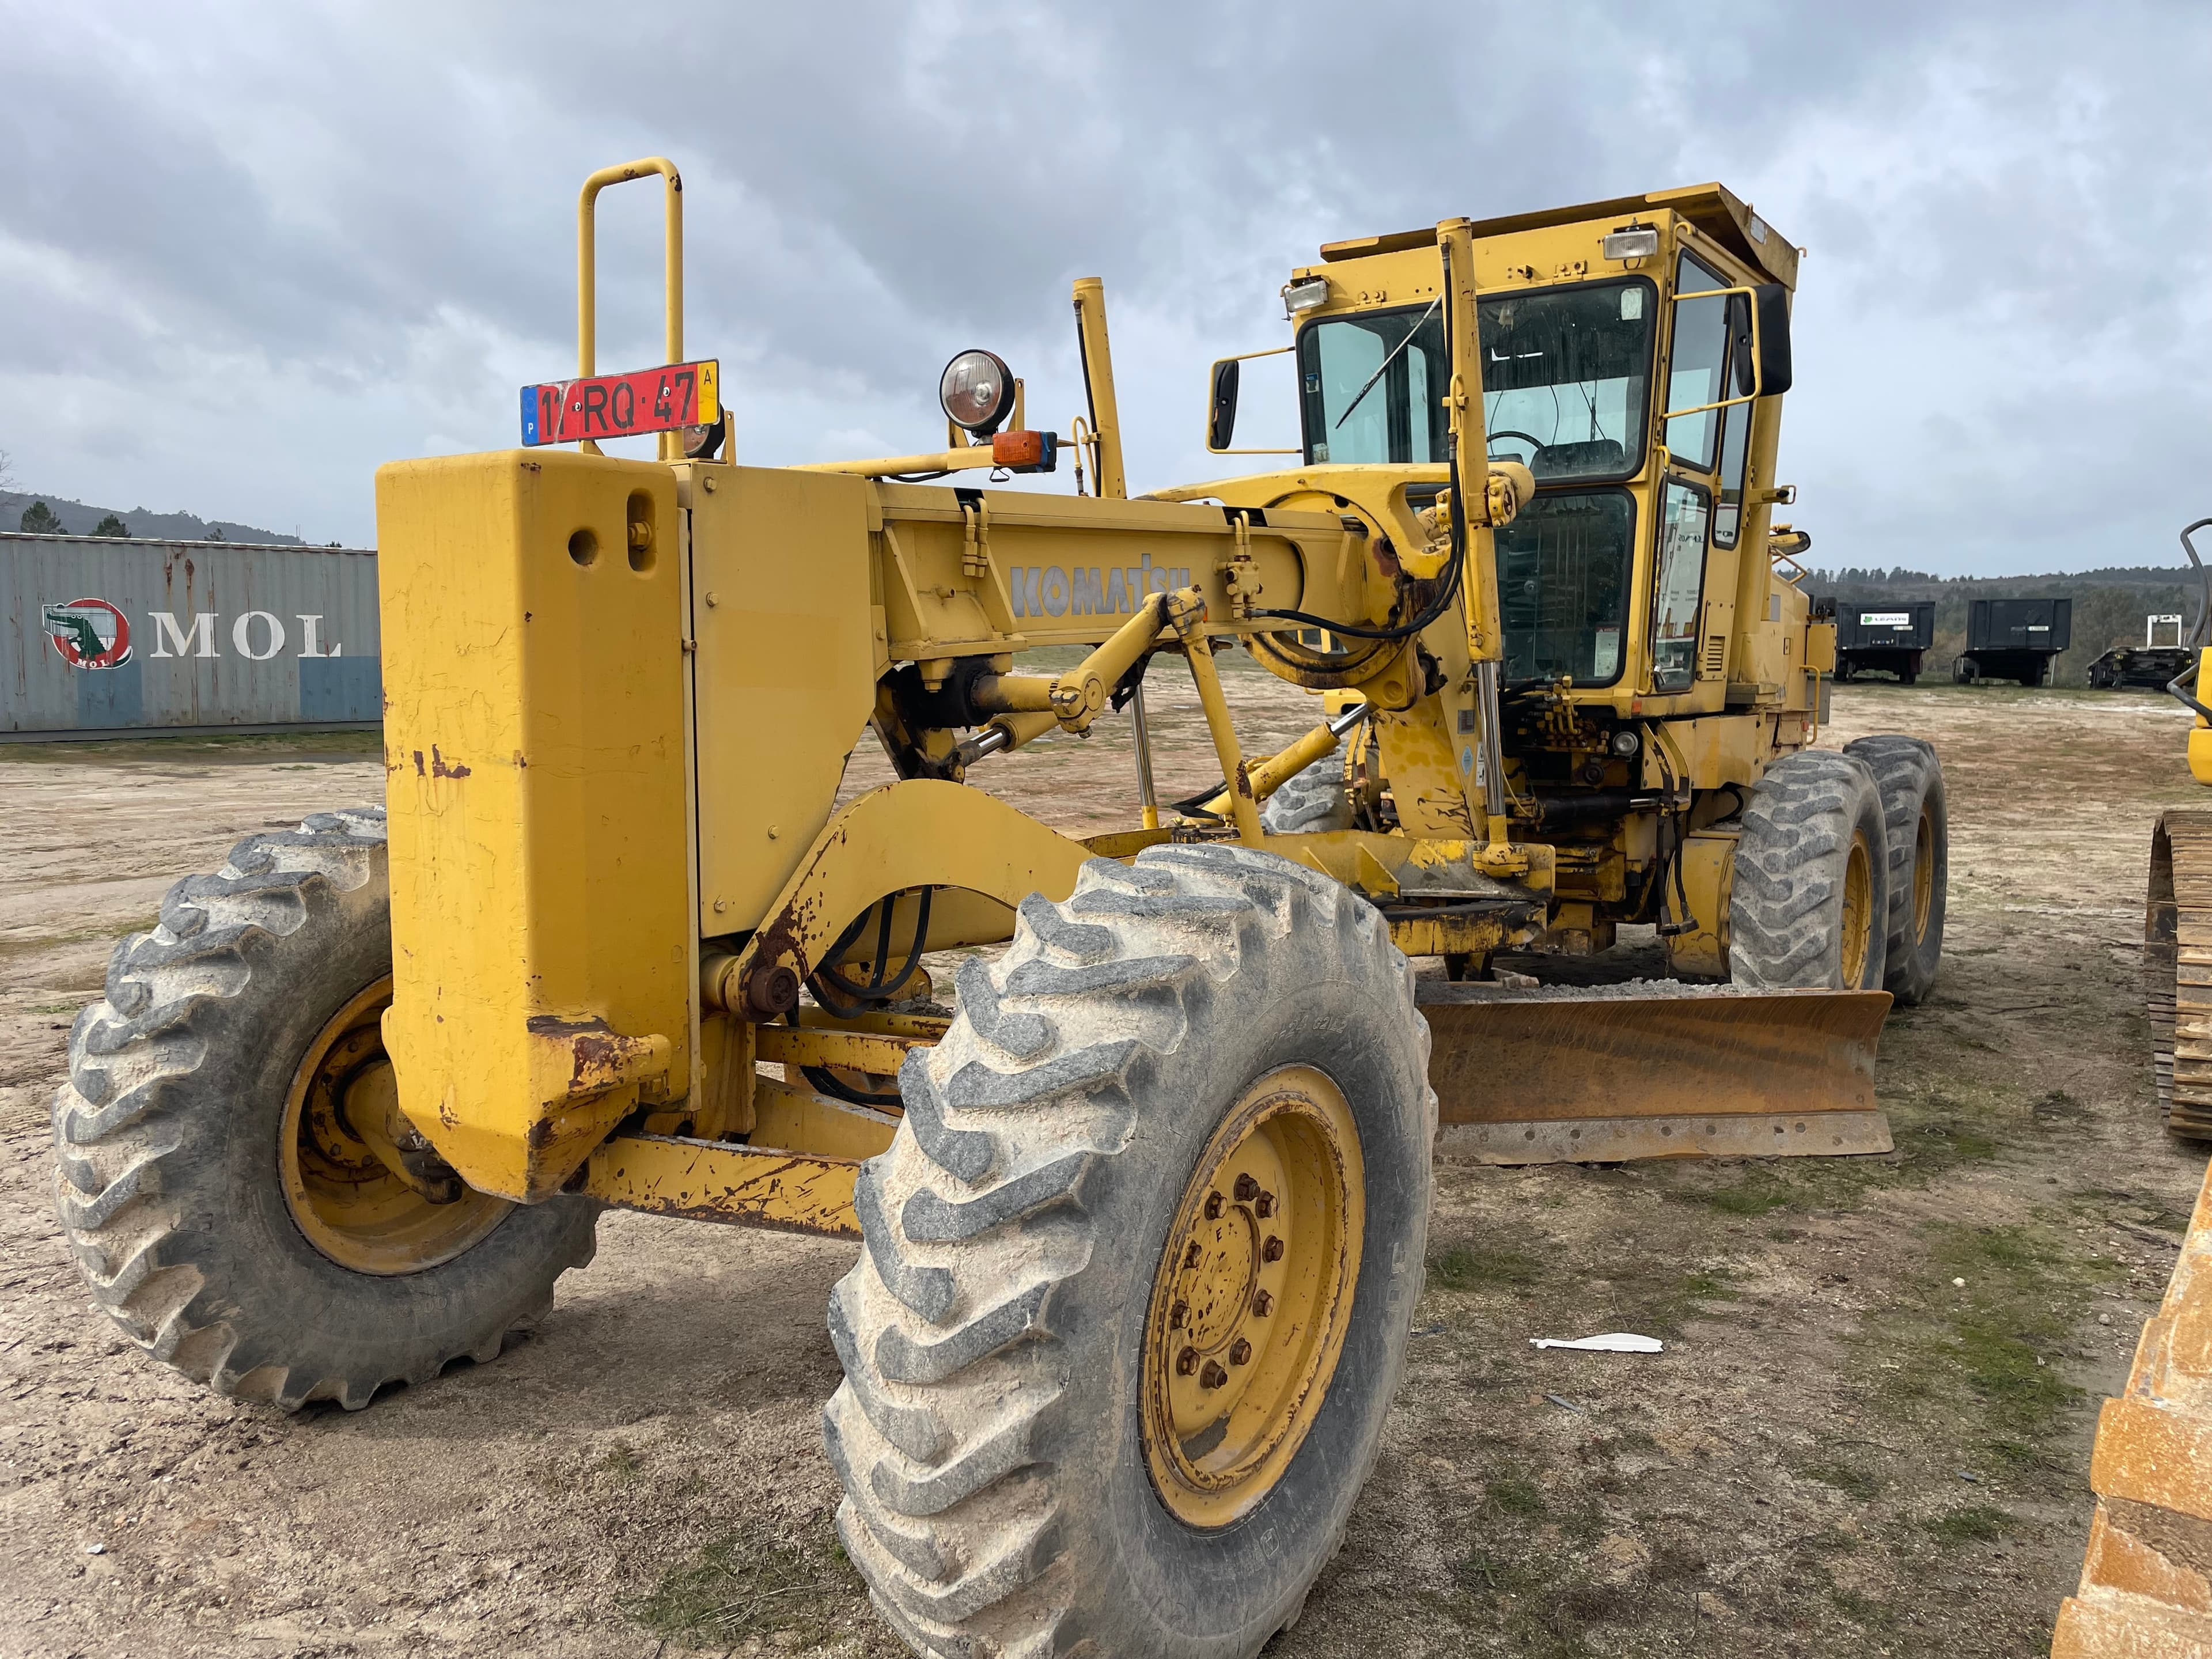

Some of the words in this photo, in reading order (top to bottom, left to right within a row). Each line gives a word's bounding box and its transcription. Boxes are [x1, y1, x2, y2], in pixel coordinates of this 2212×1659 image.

[528, 422, 533, 435] P
[703, 369, 712, 385] A
[147, 611, 342, 660] MOL
[75, 658, 109, 668] MOL
